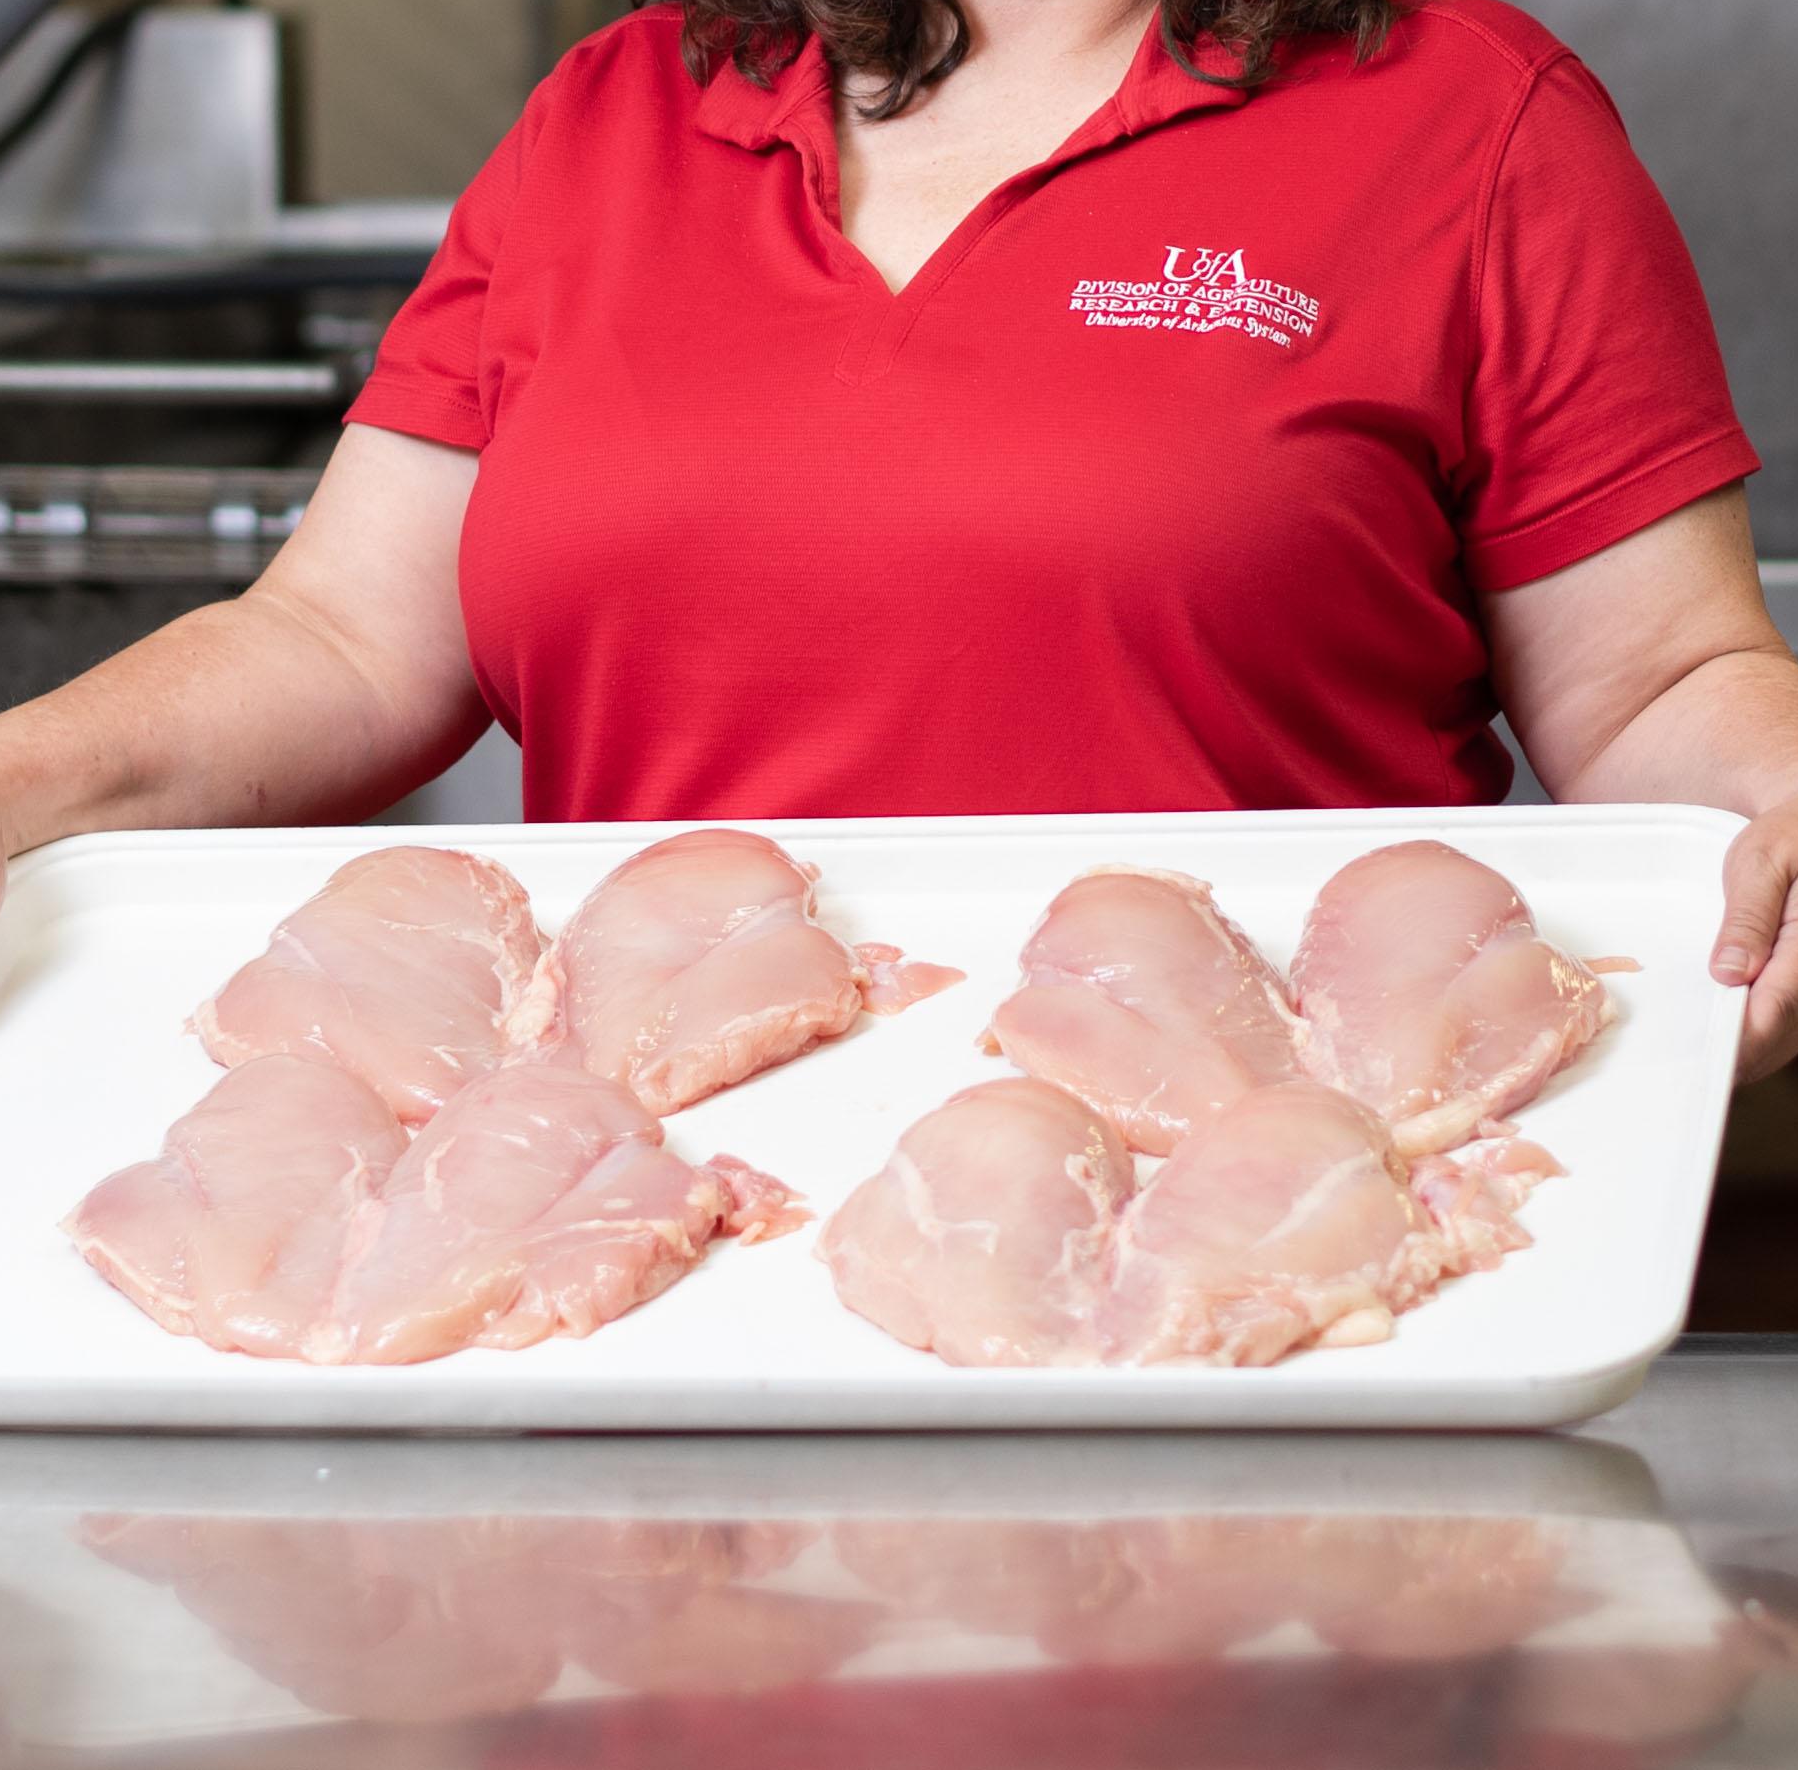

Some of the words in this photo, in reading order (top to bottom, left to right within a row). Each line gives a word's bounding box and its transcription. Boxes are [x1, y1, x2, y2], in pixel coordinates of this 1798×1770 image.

[1074, 280, 1161, 295] DIVISION
[1163, 282, 1190, 296] OF
[1193, 279, 1320, 316] AGRULTURE
[1069, 299, 1179, 312] RESEARCH
[1184, 302, 1201, 317] &
[1085, 312, 1161, 329] University
[1162, 315, 1177, 330] of
